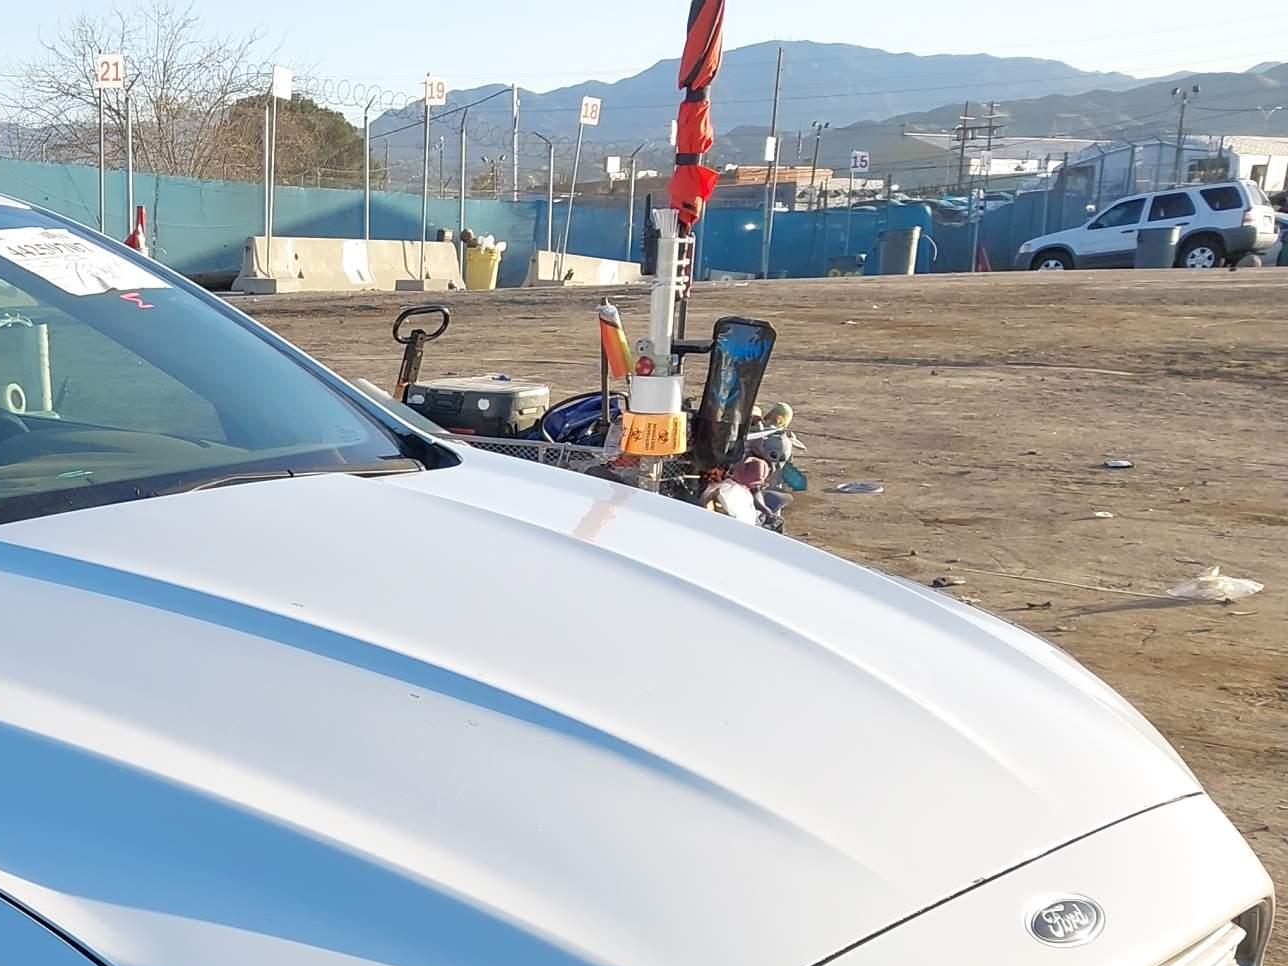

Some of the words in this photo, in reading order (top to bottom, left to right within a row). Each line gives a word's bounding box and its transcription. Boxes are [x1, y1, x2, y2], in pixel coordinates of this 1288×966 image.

[100, 60, 122, 81] 21
[427, 81, 445, 100] 19
[582, 102, 599, 120] 18
[851, 155, 868, 169] 15
[1041, 903, 1090, 938] Ford
